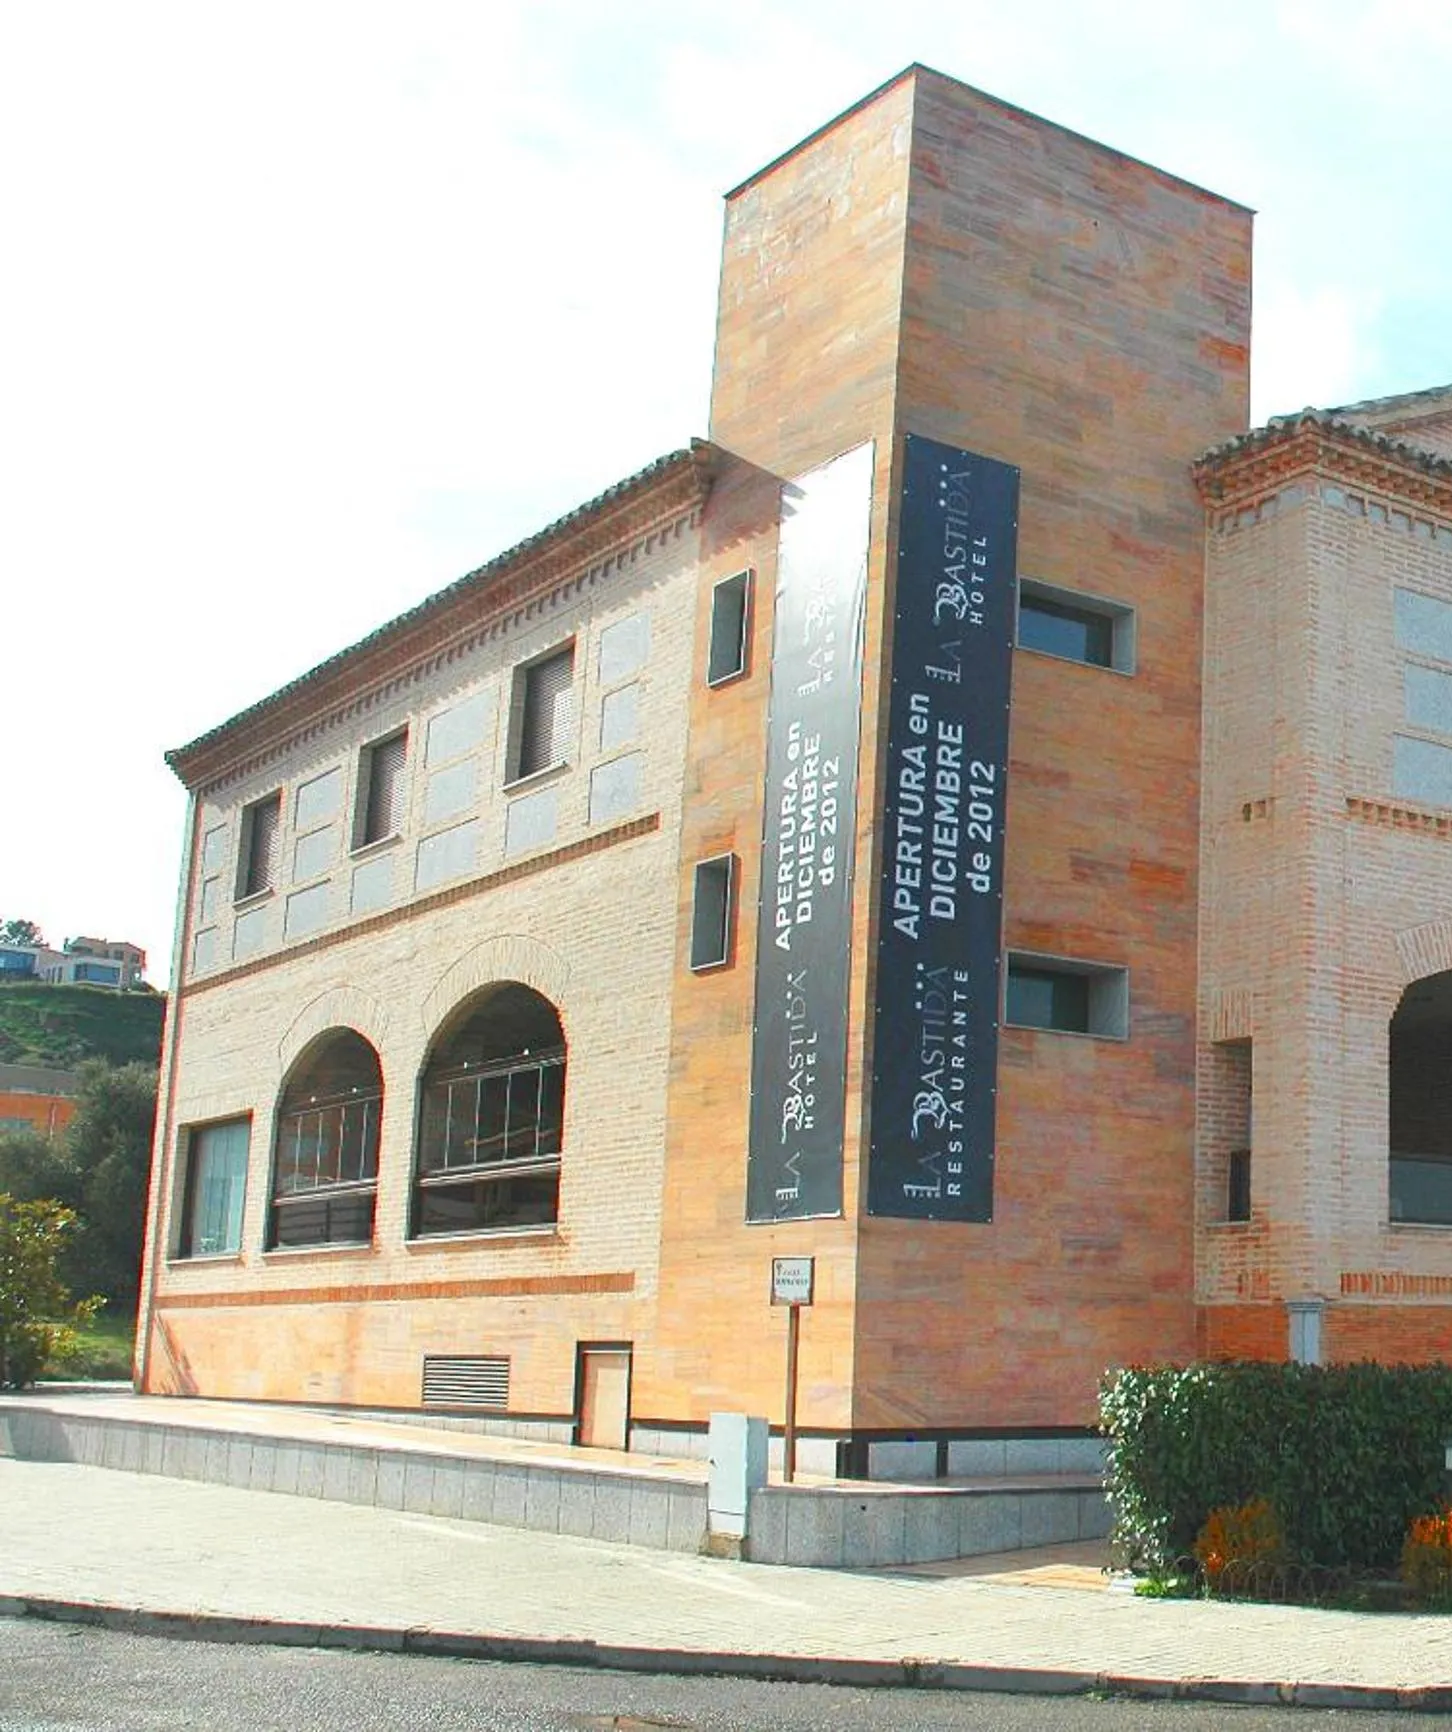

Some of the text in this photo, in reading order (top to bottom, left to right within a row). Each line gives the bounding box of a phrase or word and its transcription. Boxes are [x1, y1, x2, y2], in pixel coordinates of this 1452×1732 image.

[924, 470, 972, 684] LA BASTIDA
[969, 535, 988, 625] HOTEL
[775, 721, 801, 951] APERTURA en
[796, 733, 820, 924] DICIEMBRE
[818, 756, 839, 886] de 2012
[893, 693, 930, 940] APERTURA en
[930, 720, 963, 921] DICIEMBRE
[966, 760, 996, 893] de 2012
[775, 968, 807, 1199] LA BASTIDA
[804, 1031, 818, 1130] HOTEL
[903, 965, 949, 1199] LA BASTIDA
[946, 968, 969, 1196] RESTAURANTE
